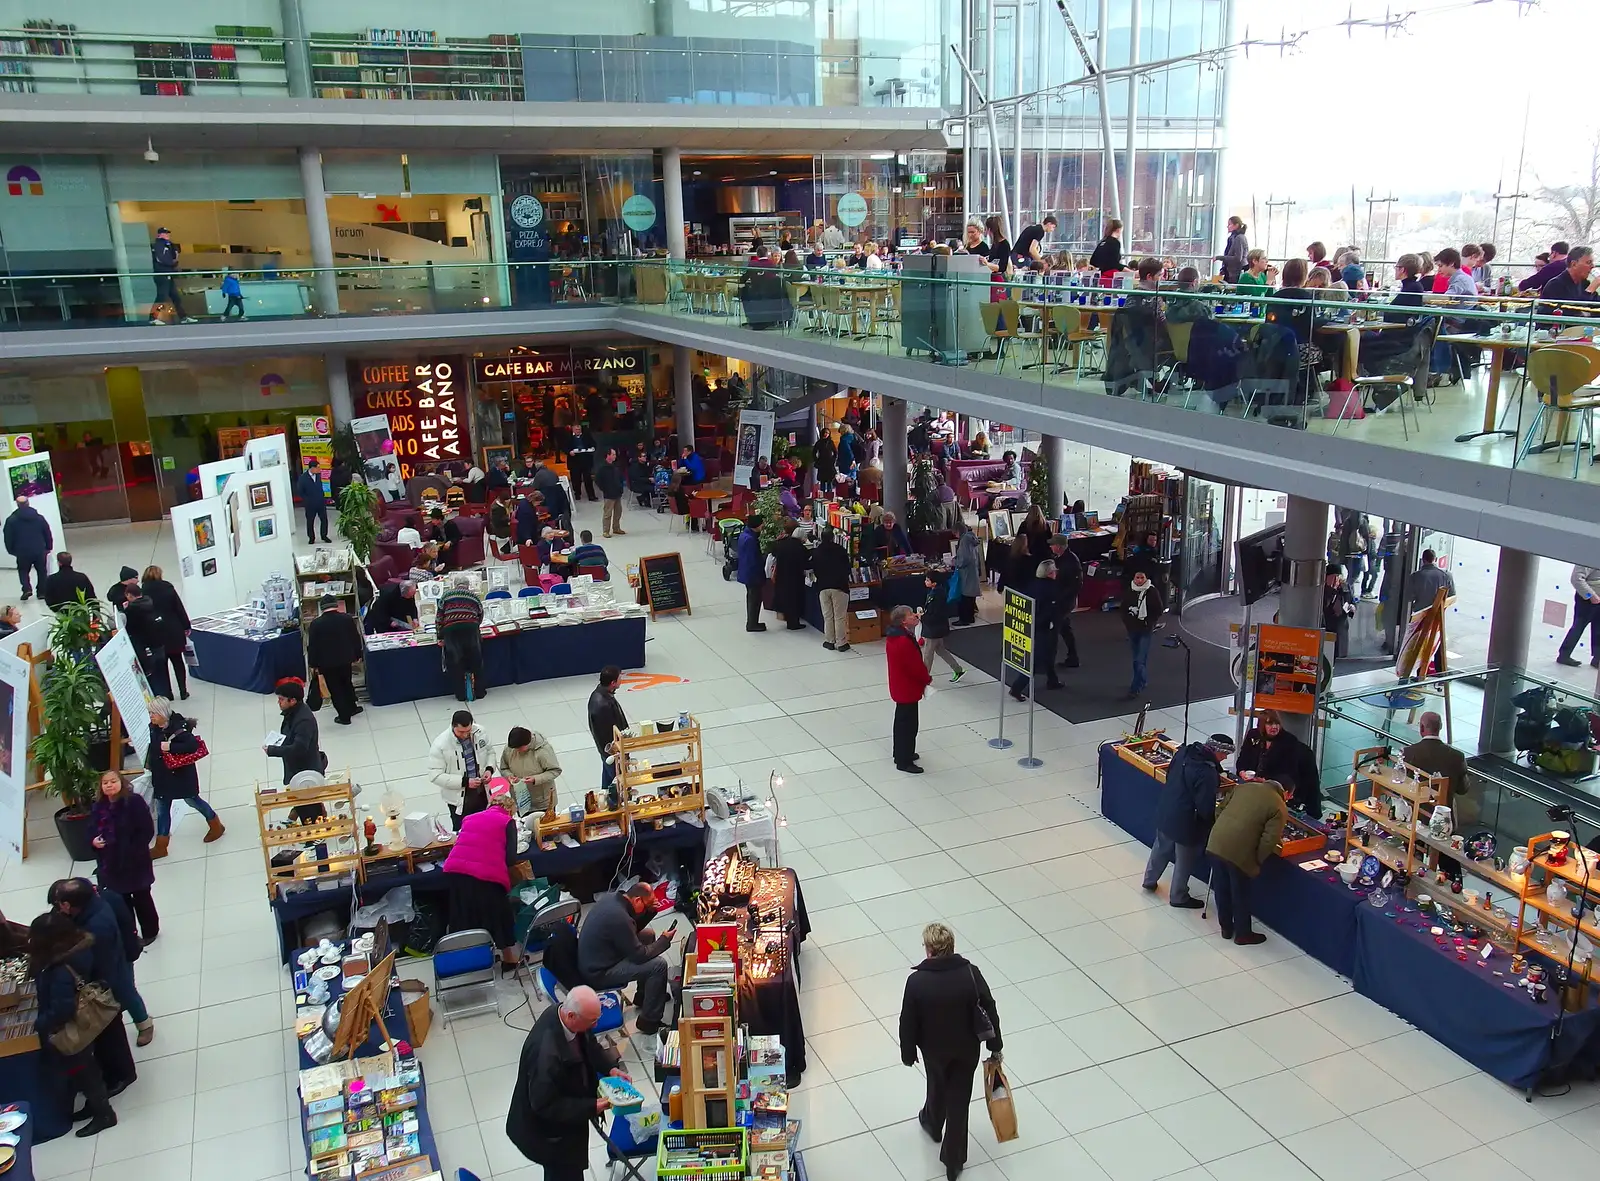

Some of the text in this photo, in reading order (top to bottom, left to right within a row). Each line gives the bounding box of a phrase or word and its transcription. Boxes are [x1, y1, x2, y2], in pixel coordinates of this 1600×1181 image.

[335, 226, 364, 238] forum
[519, 230, 540, 240] PIZZA
[514, 239, 544, 249] EXPRESS
[363, 364, 410, 384] COFFEE
[484, 356, 636, 377] CAFE BAR MARZANO
[366, 389, 413, 409] CAKES
[414, 363, 441, 460] AFE BAR
[435, 362, 461, 455] ARZANO
[391, 414, 416, 432] ADS
[1011, 594, 1027, 609] NEXT
[1004, 603, 1033, 625] ANTIQUES
[1011, 619, 1025, 634] FAIR
[1010, 631, 1026, 648] HERE
